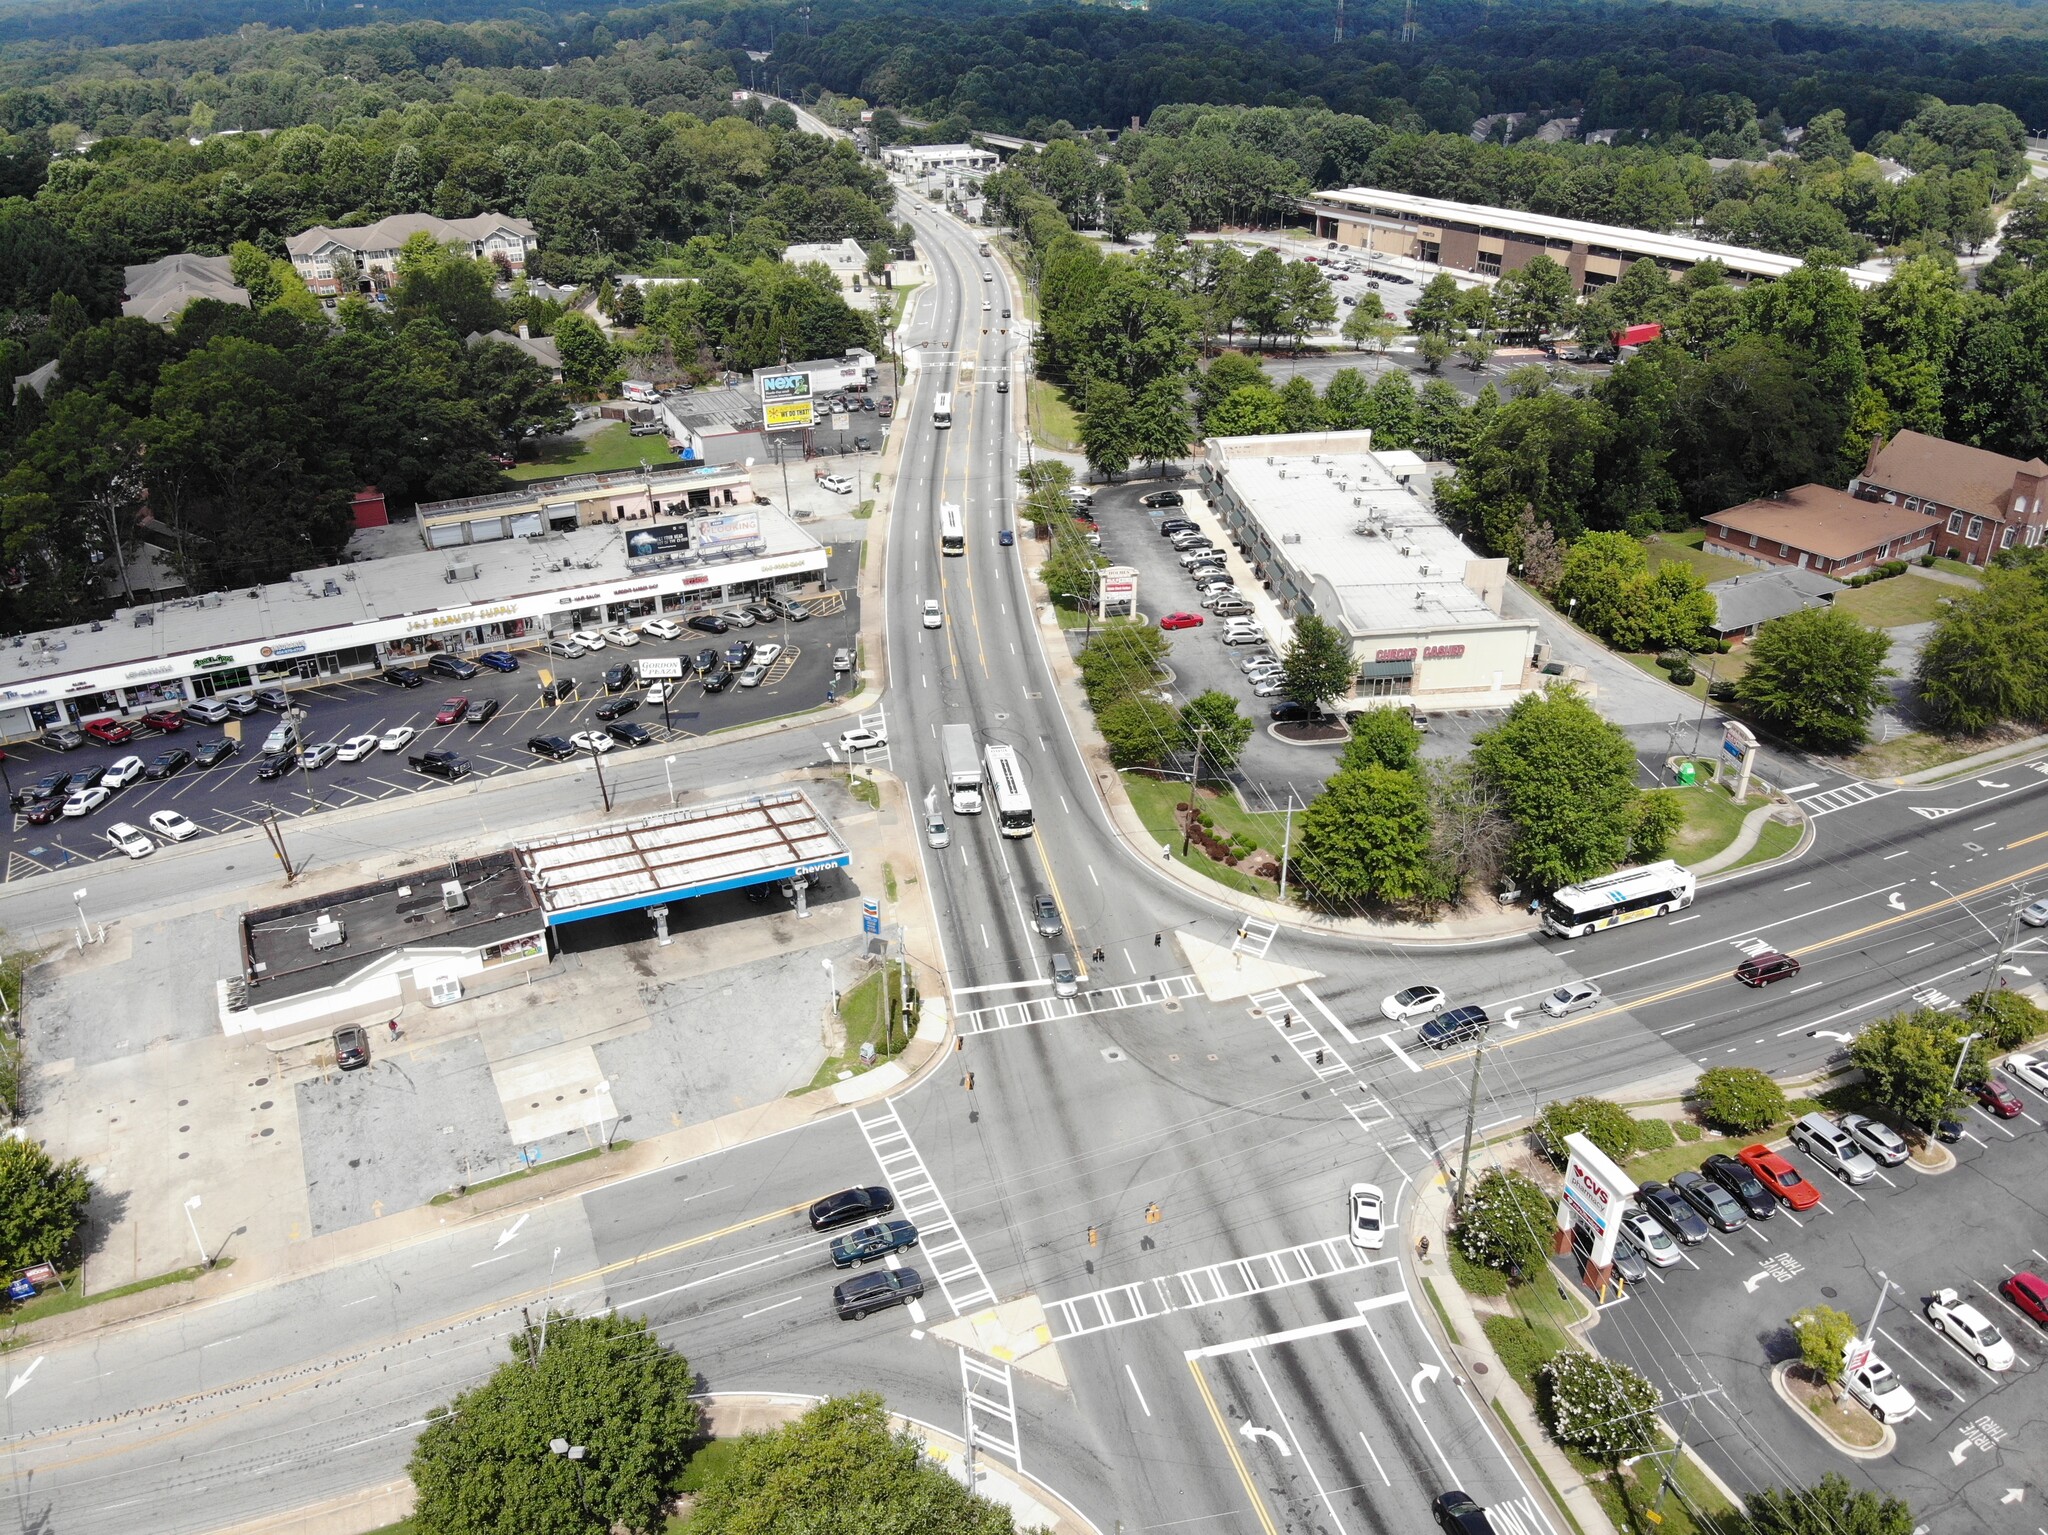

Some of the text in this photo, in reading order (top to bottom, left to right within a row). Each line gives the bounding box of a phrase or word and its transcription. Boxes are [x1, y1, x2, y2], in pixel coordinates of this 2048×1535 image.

[711, 521, 757, 534] LOOKING
[432, 610, 476, 627] BEAUTY
[479, 604, 518, 619] SUPPLY
[1376, 645, 1466, 662] CHECKS CASHED
[641, 661, 679, 672] GORDON
[795, 861, 838, 876] Chevron
[1571, 1177, 1606, 1212] pharmacy
[1584, 1175, 1608, 1205] CVS
[1758, 1257, 1792, 1283] DRIVE
[1774, 1252, 1806, 1276] THRU
[1958, 1421, 1997, 1452] DRIVE
[1974, 1415, 2008, 1442] THRU
